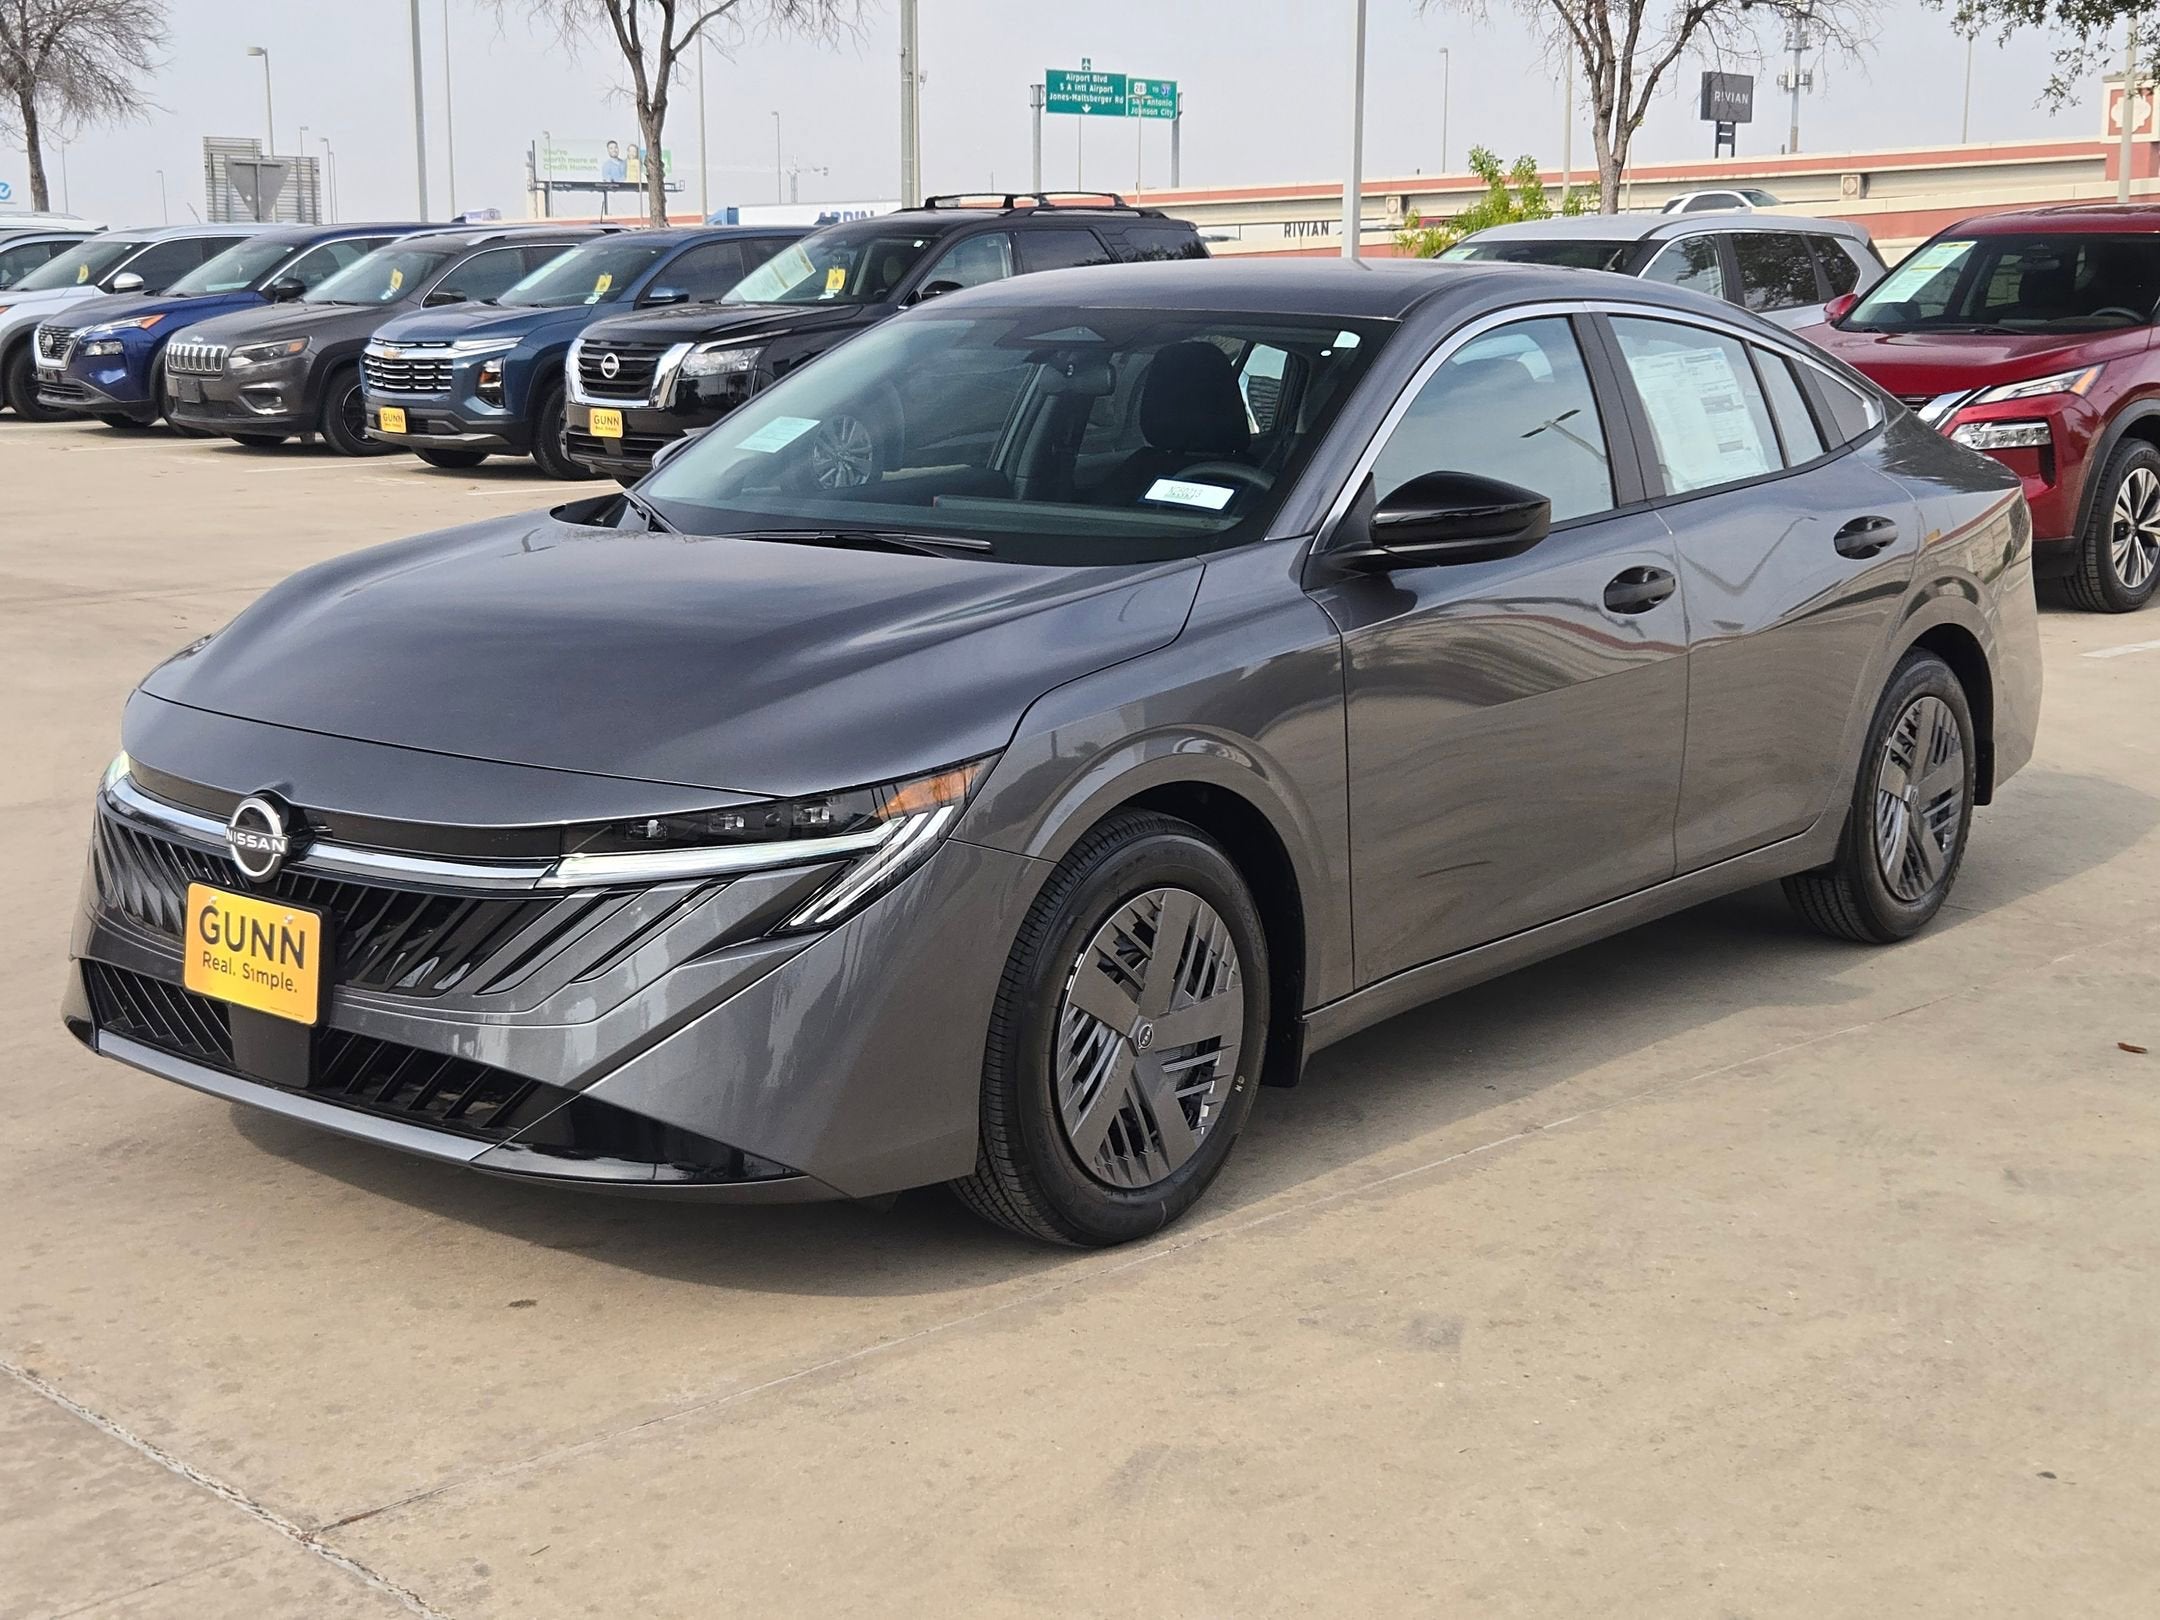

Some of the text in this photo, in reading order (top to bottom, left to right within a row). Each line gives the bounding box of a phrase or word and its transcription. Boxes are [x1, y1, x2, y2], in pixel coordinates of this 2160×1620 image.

[1066, 73, 1108, 83] Airport Blvd
[1066, 83, 1072, 91] A
[1074, 84, 1087, 92] Intl
[1089, 85, 1113, 95] Airport
[1049, 92, 1124, 105] Jones-Maltsberger Rd
[1147, 98, 1173, 107] Antonio
[1714, 91, 1749, 104] RIVIAN
[1130, 106, 1174, 118] Jonson City
[1284, 221, 1329, 238] RIVIAN
[383, 412, 403, 423] GUNN
[593, 415, 620, 425] GUNN
[226, 828, 285, 852] NISSAN
[199, 905, 305, 970] GUNN
[202, 950, 236, 976] Real.
